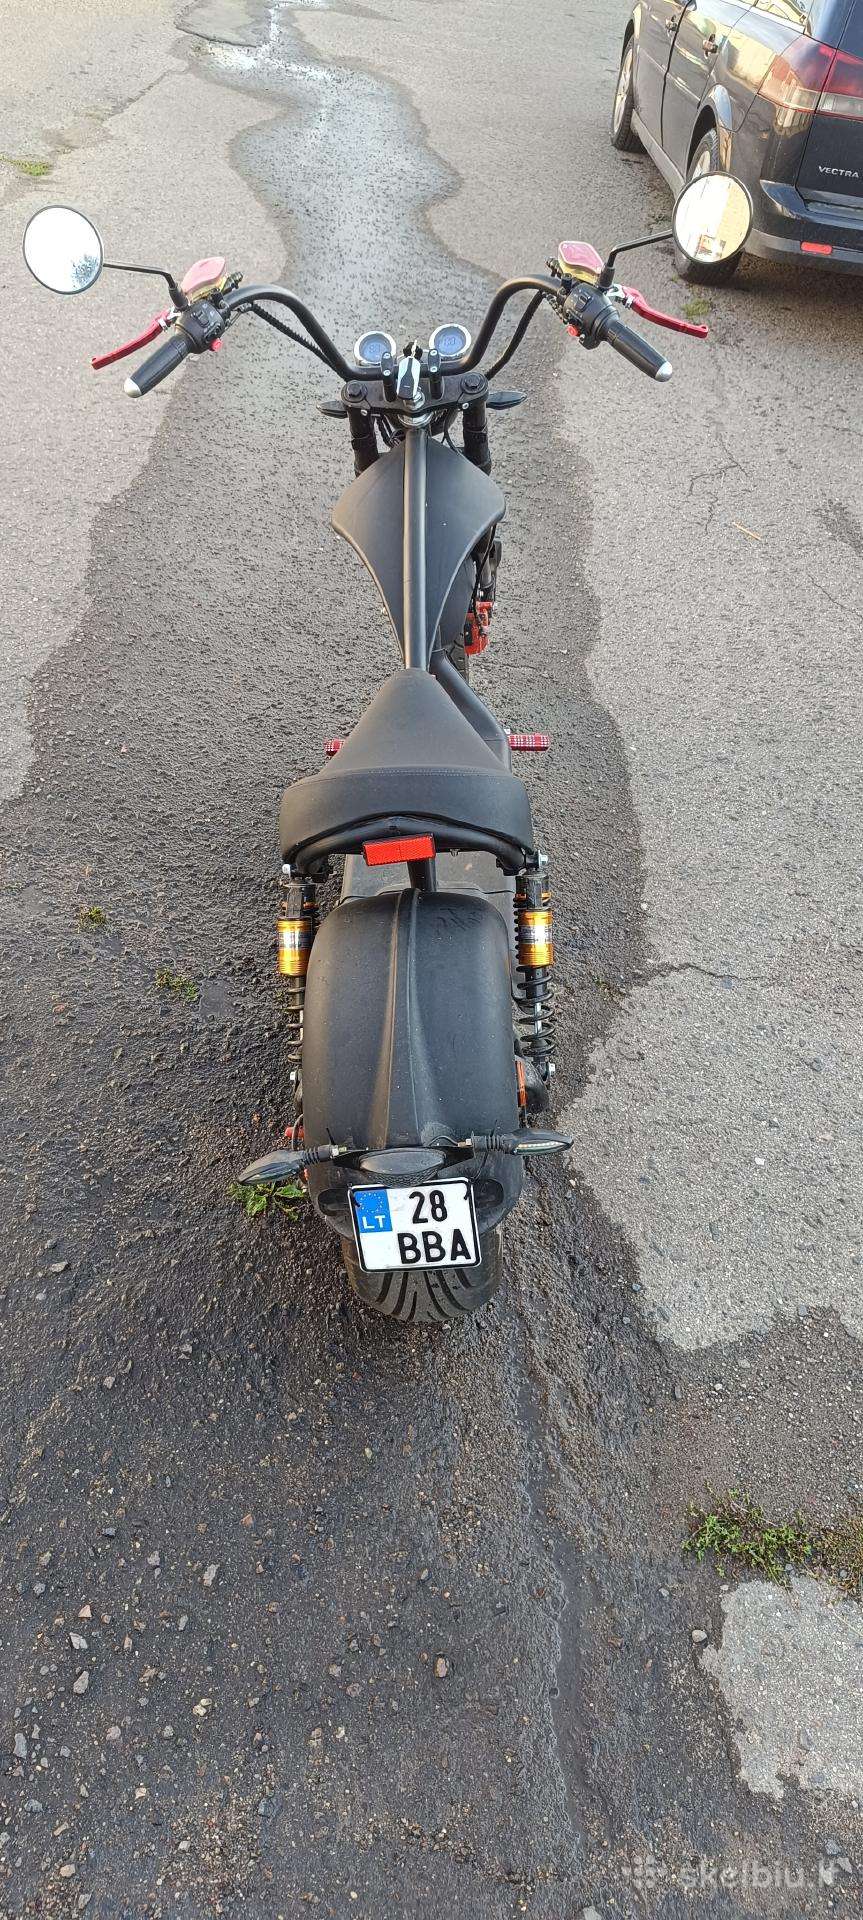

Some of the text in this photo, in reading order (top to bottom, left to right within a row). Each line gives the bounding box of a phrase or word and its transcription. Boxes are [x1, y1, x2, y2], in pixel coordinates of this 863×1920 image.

[818, 165, 859, 178] VECTRA
[408, 1190, 448, 1224] 28
[362, 1215, 386, 1229] LT
[397, 1229, 471, 1264] BBA
